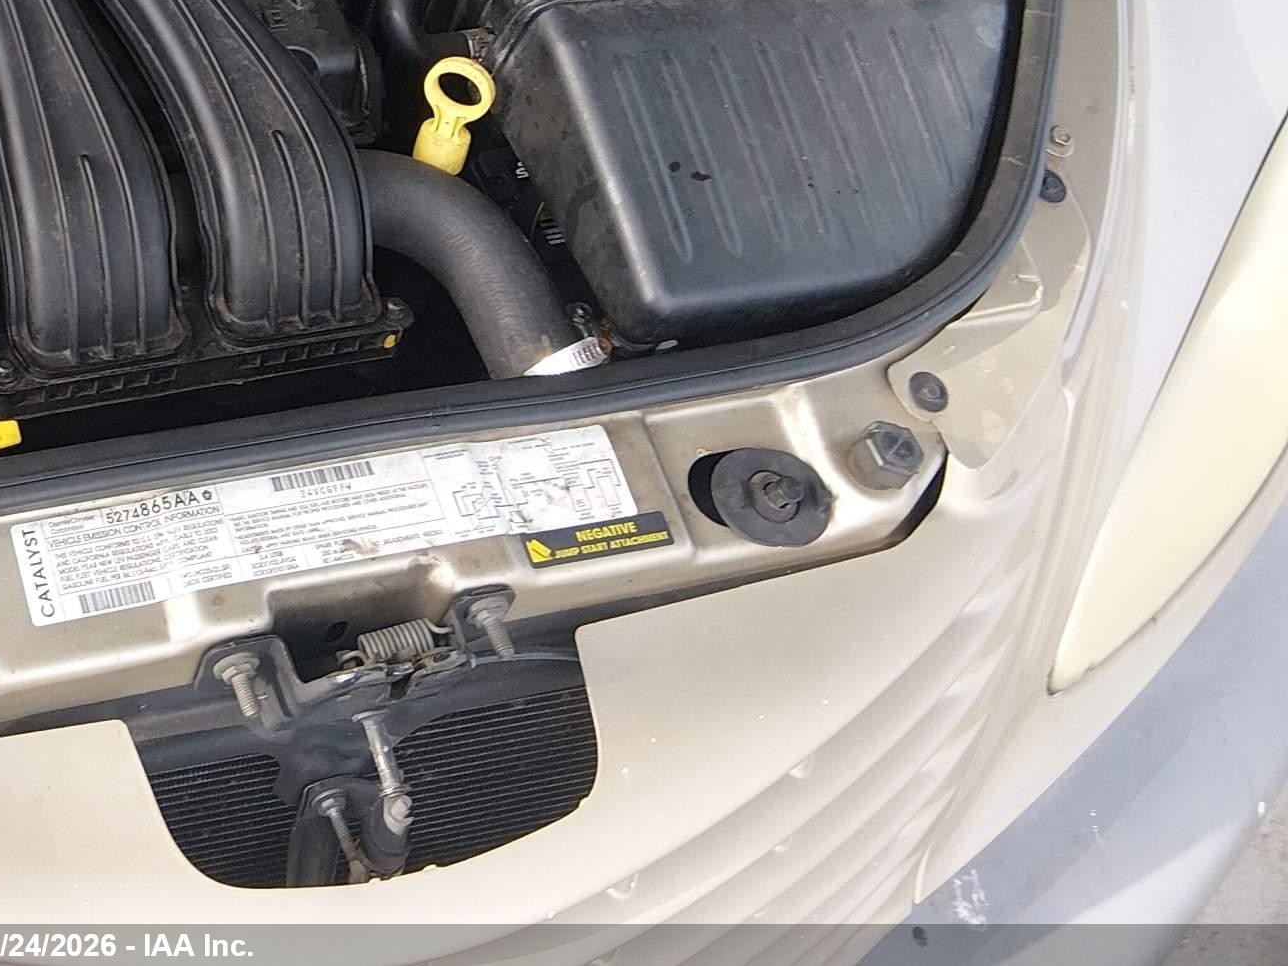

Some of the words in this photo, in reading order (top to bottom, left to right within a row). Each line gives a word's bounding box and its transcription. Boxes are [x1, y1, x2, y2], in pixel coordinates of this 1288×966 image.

[106, 490, 201, 524] 5274865AA
[48, 535, 82, 548] VEHICLE
[82, 527, 122, 542] EMISSION
[123, 519, 162, 534] CONTROL
[164, 506, 221, 522] INFORMATION
[575, 521, 638, 542] NEGATIVE
[554, 548, 580, 559] JUMP
[581, 542, 609, 554] START
[610, 531, 669, 549] ATTACHMENT
[21, 528, 56, 619] CATALYST
